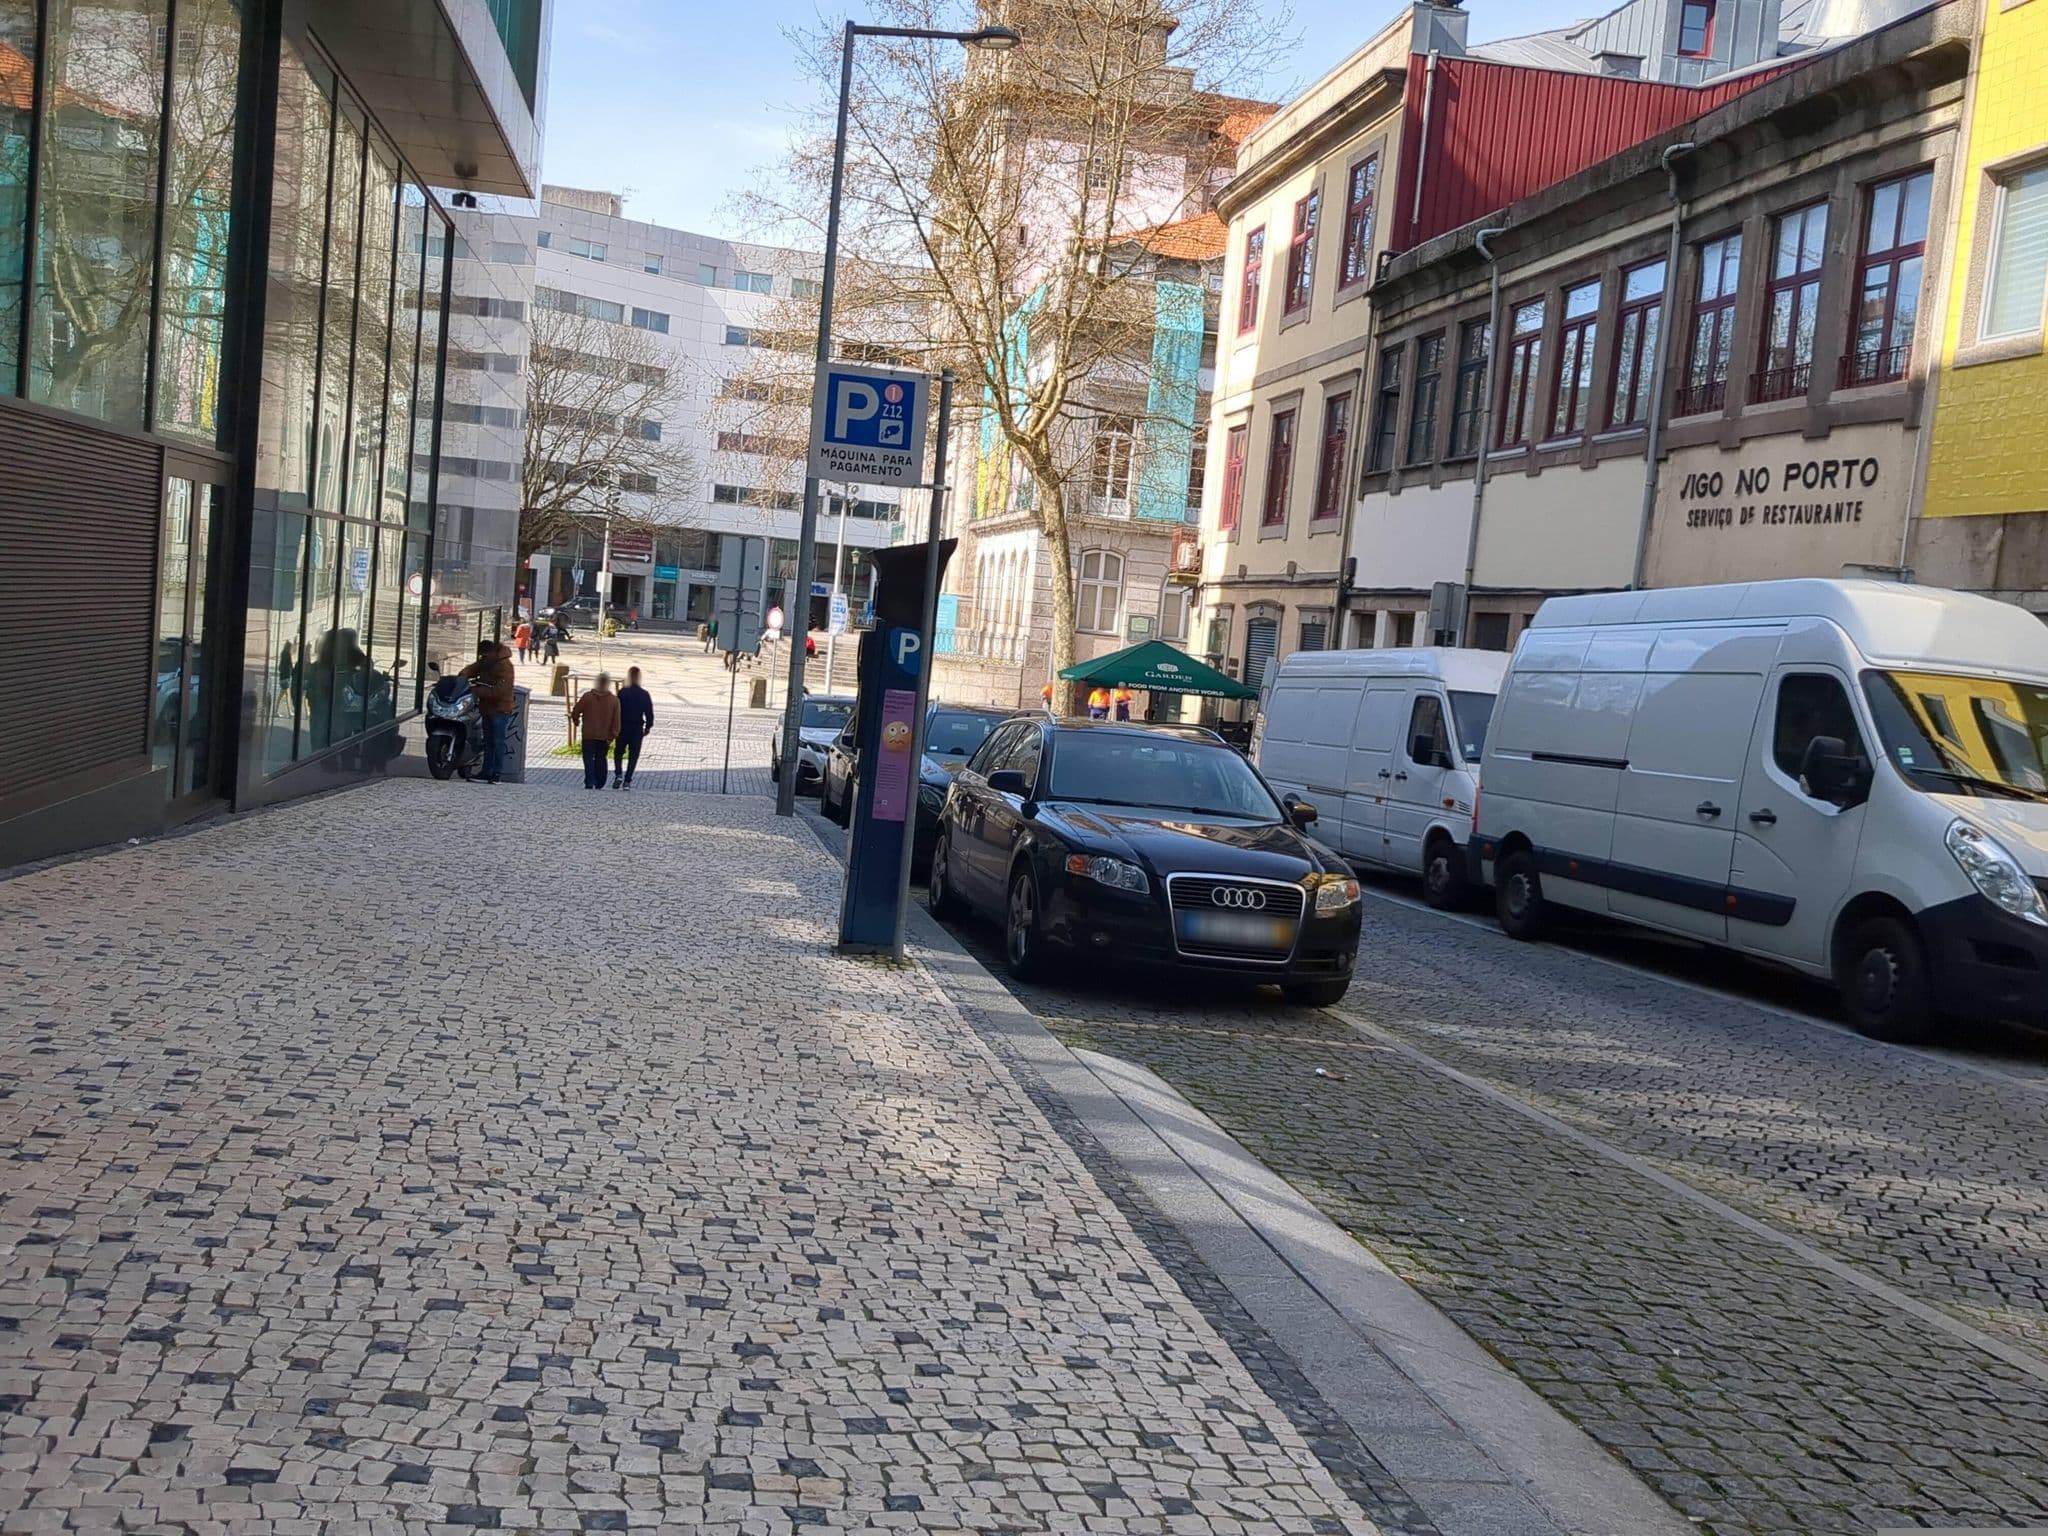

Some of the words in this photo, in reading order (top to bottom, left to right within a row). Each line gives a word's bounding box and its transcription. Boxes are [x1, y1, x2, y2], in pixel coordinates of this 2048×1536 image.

[834, 380, 880, 439] P
[882, 403, 903, 419] Z12
[820, 447, 876, 463] MÁQUINA
[882, 454, 913, 466] PARA
[830, 461, 902, 477] PAGAMENTO
[1734, 466, 1770, 496] NO
[1783, 457, 1879, 491] PORTO
[1686, 506, 1732, 530] SERVIÇO
[1762, 501, 1863, 526] RESTAURANTE
[897, 632, 921, 665] P
[1127, 682, 1147, 690] FOOD
